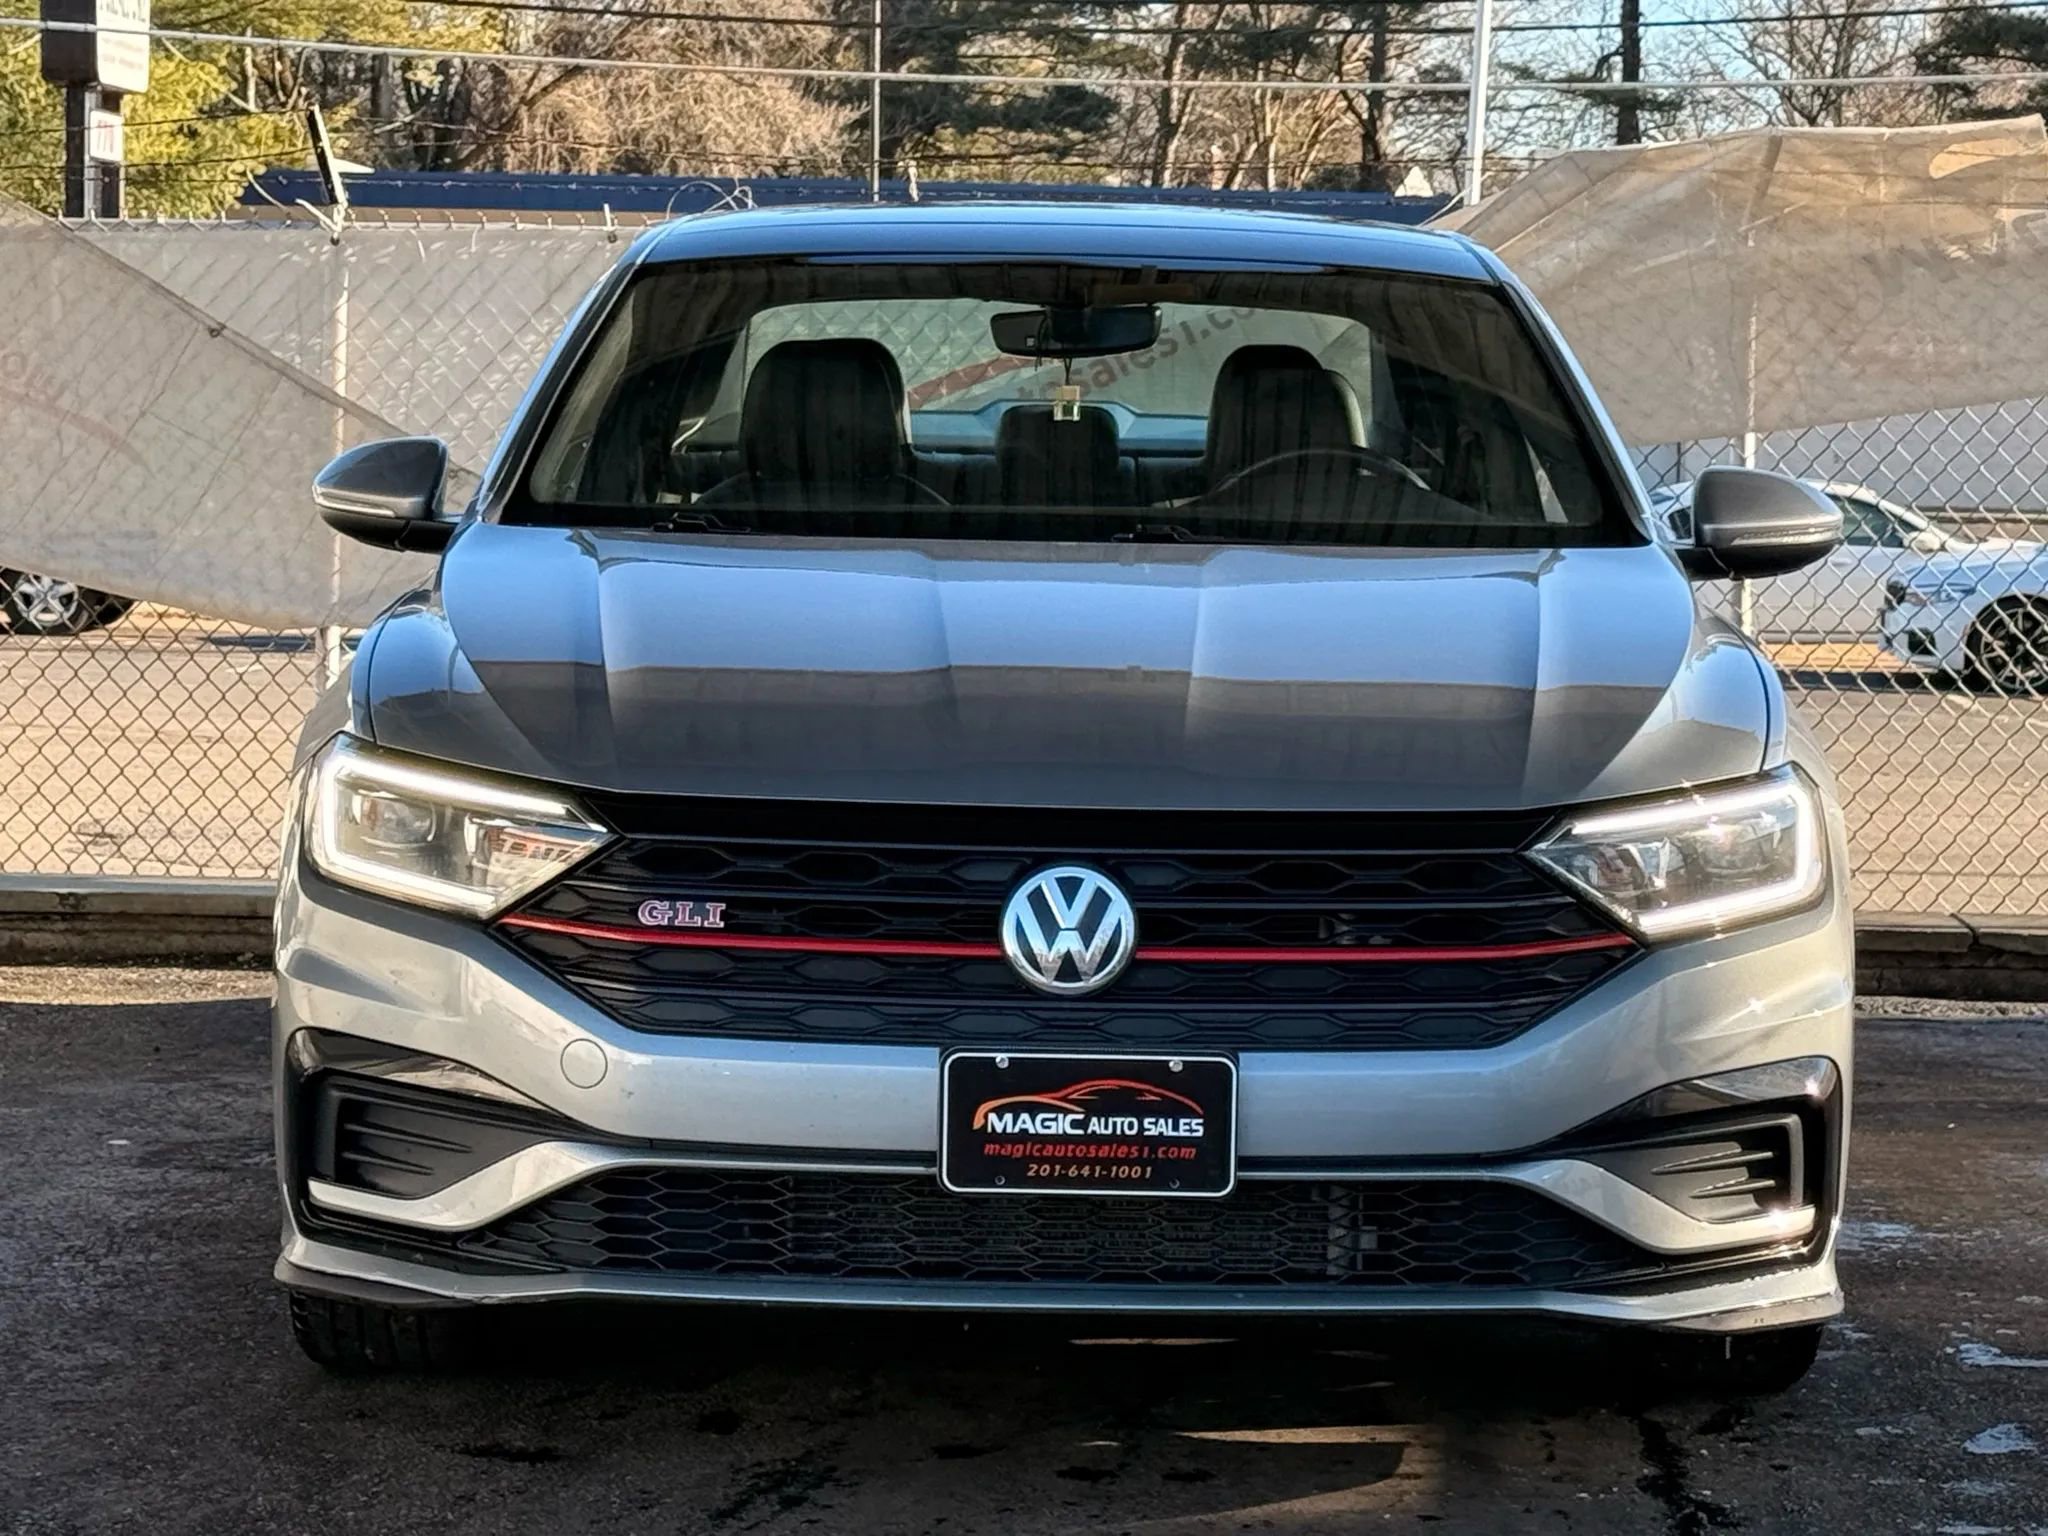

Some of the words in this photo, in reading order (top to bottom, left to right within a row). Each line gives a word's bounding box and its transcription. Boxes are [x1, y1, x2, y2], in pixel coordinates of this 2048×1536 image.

[637, 900, 727, 929] GLI
[986, 1112, 1085, 1136] MAGIC
[1087, 1116, 1138, 1136] AUTO
[1143, 1117, 1204, 1137] SALES
[983, 1141, 1197, 1160] magicautosales1.com
[1026, 1163, 1153, 1179] 201-641-1001
